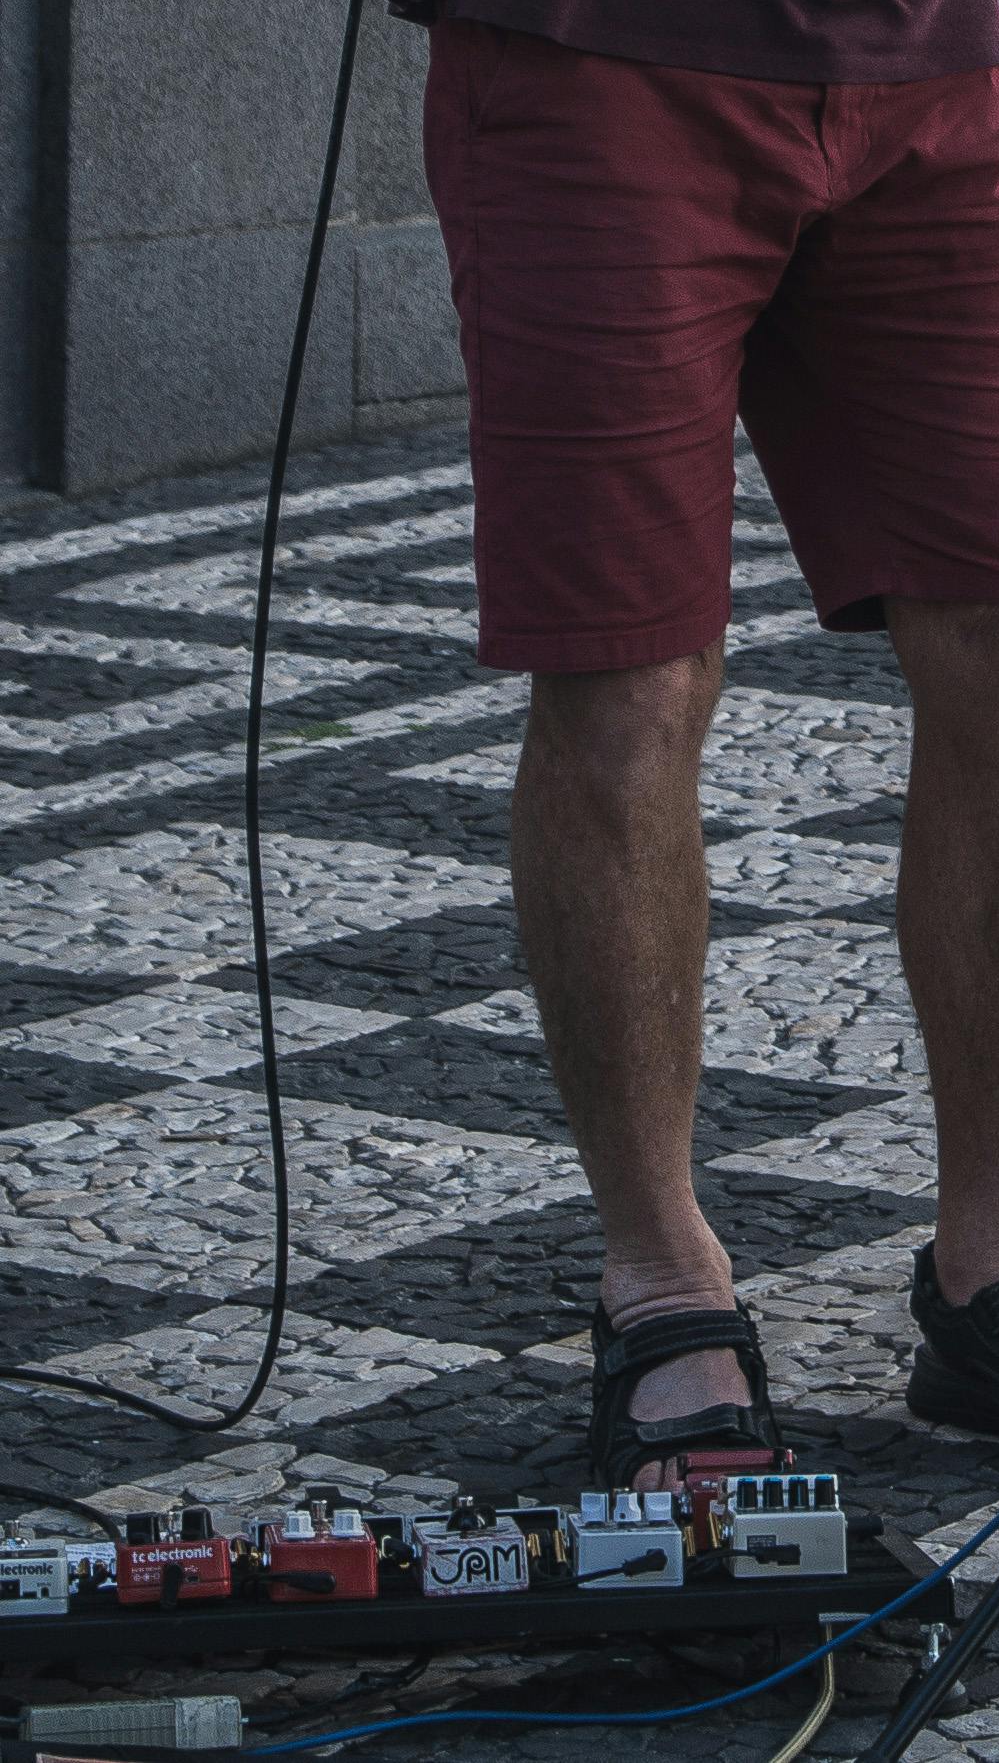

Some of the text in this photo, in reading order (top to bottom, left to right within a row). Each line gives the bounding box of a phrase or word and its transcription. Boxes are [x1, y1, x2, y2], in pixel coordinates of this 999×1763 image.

[131, 1544, 214, 1564] tc electronic
[430, 1543, 522, 1584] JAM
[0, 1562, 54, 1576] lectronic
